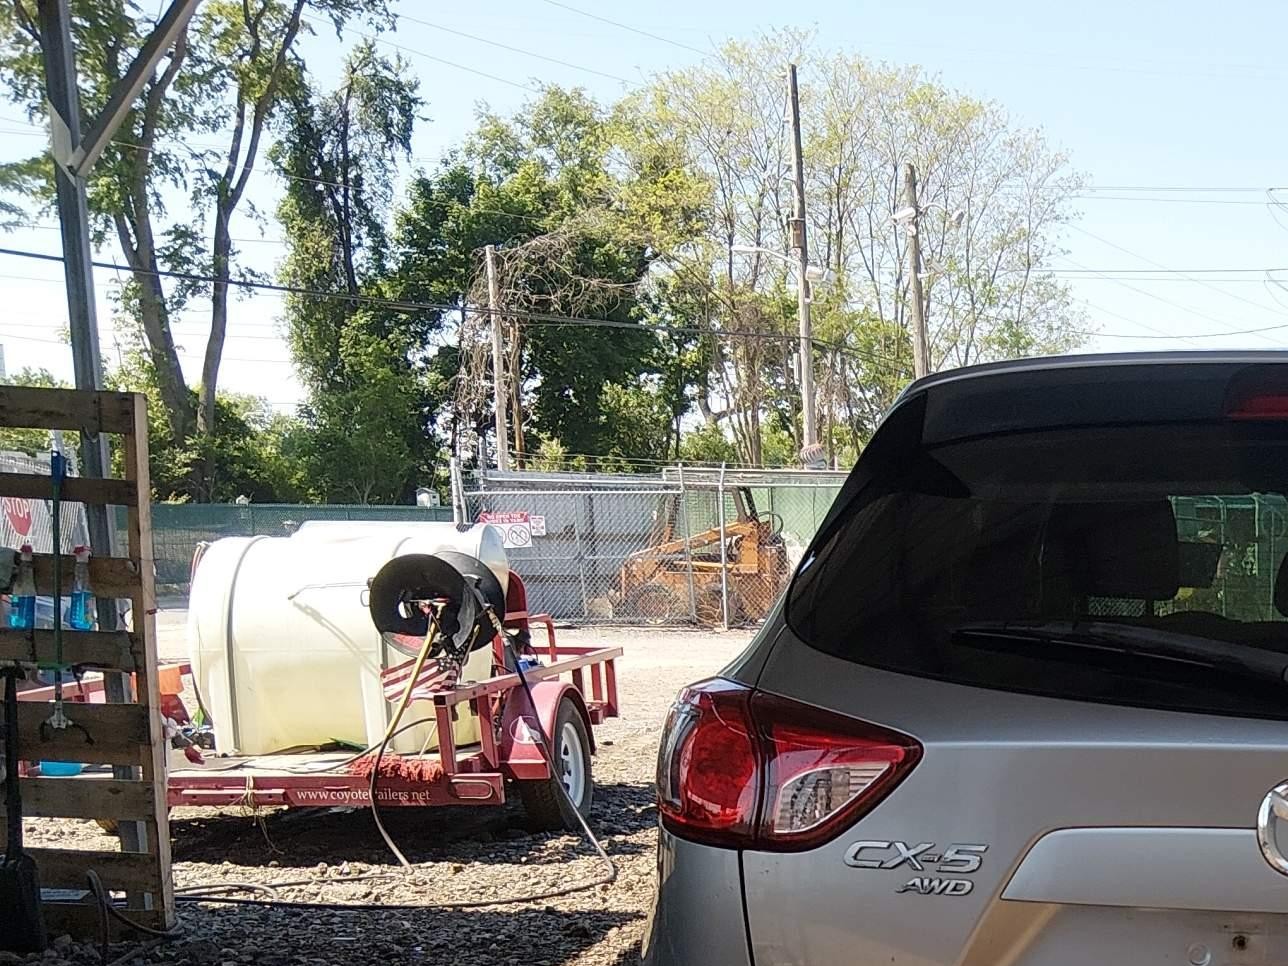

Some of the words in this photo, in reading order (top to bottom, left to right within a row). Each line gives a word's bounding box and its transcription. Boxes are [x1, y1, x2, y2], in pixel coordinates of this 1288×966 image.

[5, 497, 29, 519] STOP
[843, 840, 990, 873] CX-5
[897, 877, 974, 896] AWD
